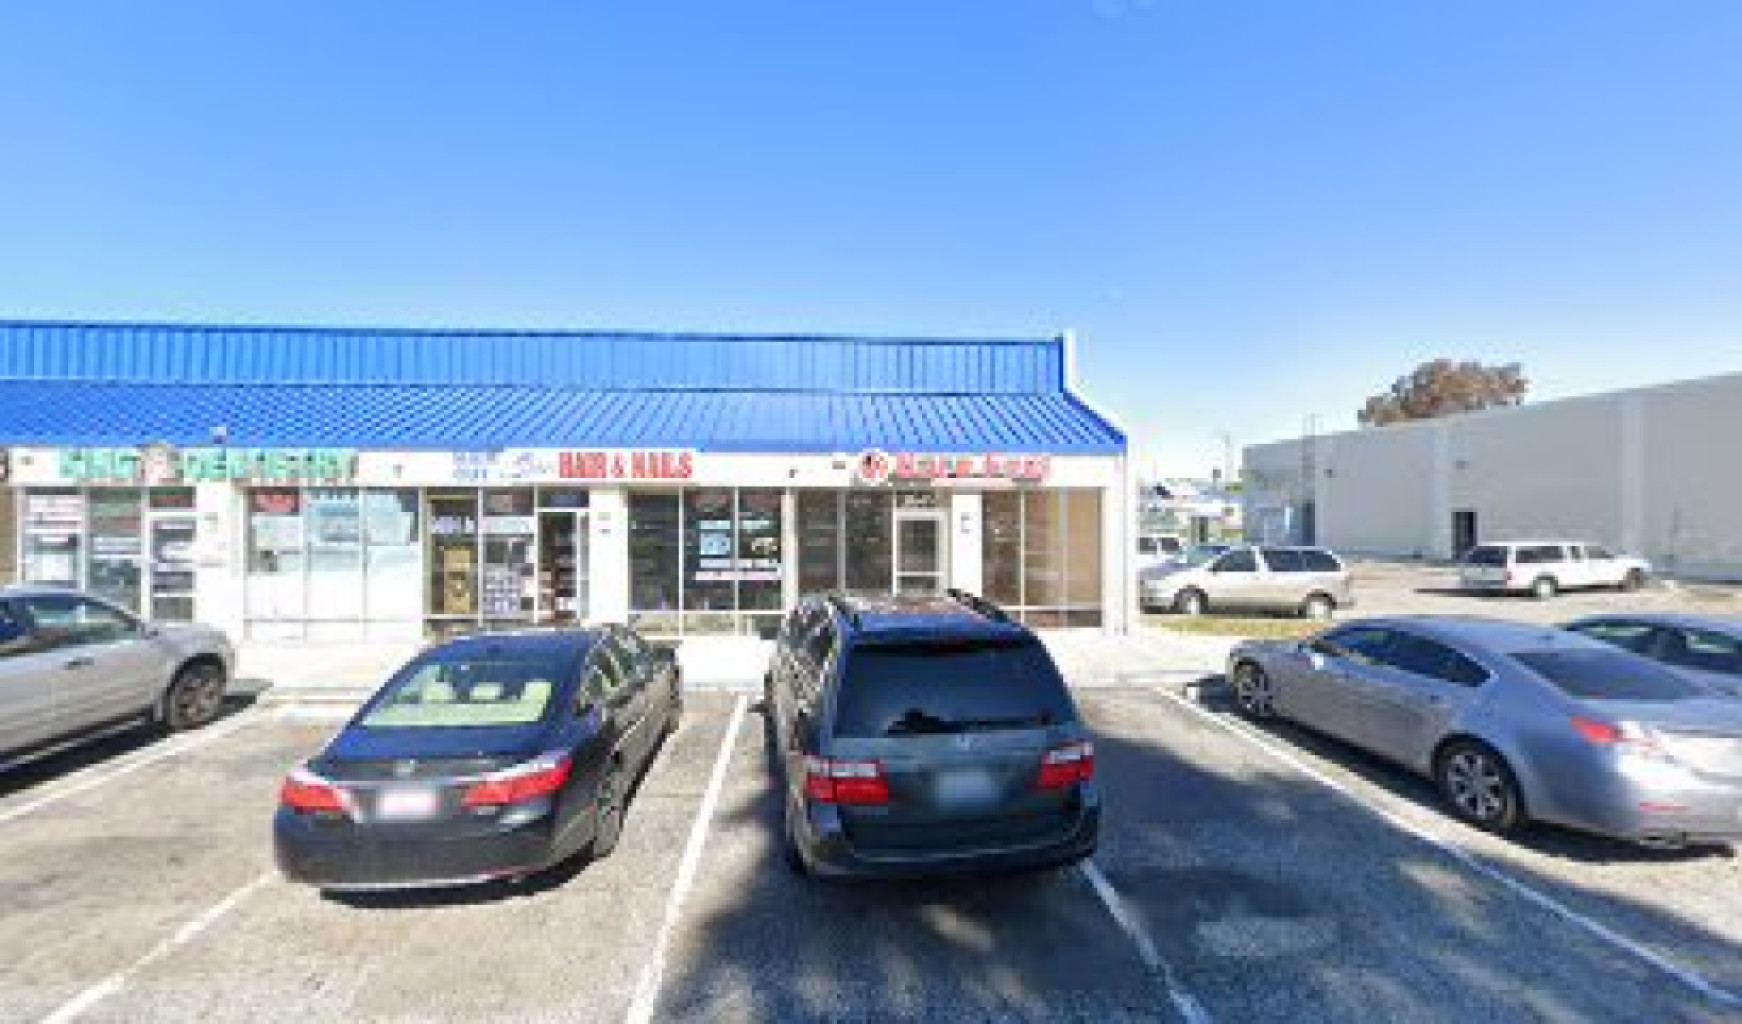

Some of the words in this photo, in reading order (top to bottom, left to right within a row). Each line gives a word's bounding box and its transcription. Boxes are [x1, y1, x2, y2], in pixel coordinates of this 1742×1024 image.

[558, 452, 607, 479] HAIR
[611, 452, 625, 479] &
[631, 452, 693, 479] NAILS
